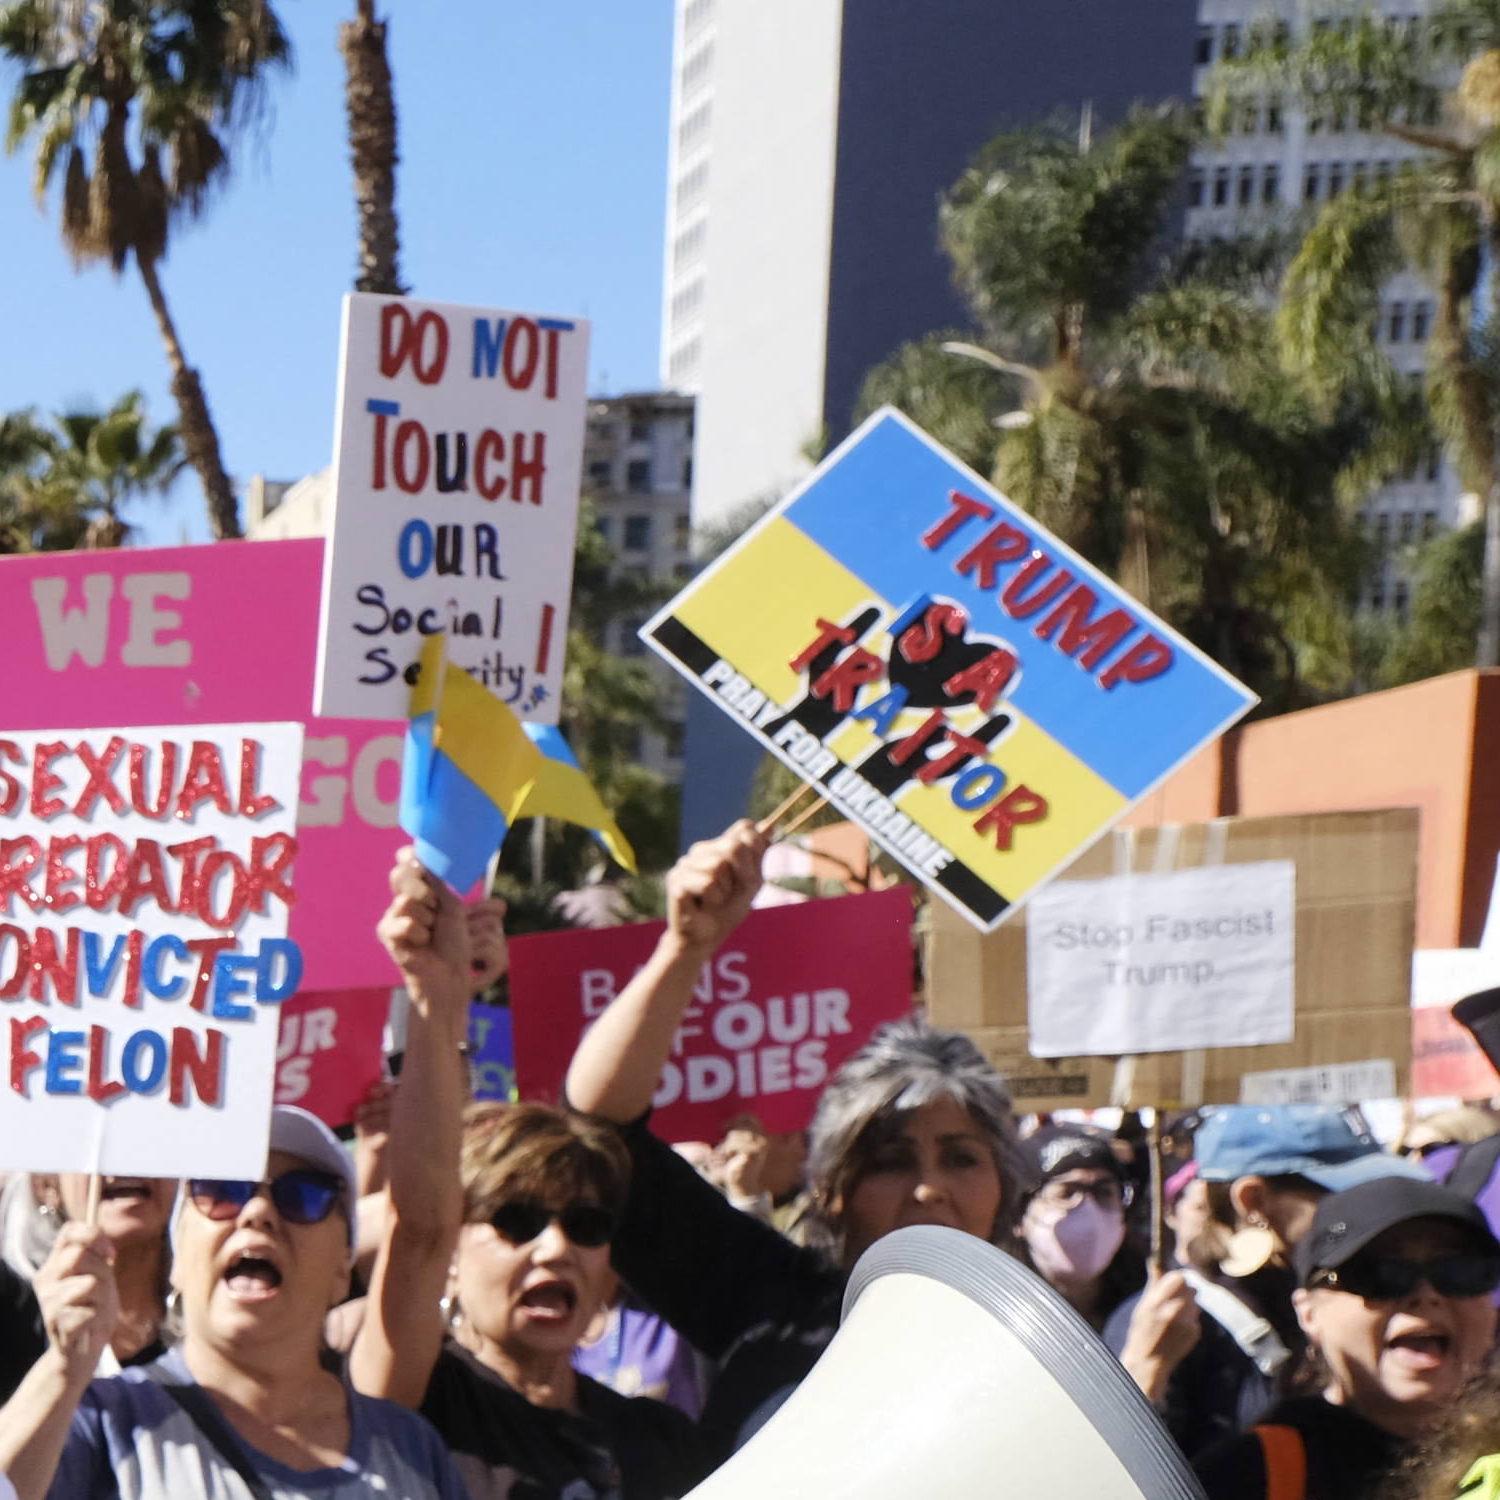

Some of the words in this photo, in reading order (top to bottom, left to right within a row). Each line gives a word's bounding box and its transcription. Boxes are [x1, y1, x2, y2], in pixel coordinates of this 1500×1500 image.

[380, 303, 449, 386] DO
[472, 317, 575, 400] NOT
[367, 398, 546, 506] TOUCH
[399, 518, 507, 580] OUR
[921, 489, 1174, 691] TRUMP
[31, 572, 192, 671] WE
[353, 585, 502, 638] Social
[888, 592, 966, 663] IS
[942, 648, 1020, 713] A
[701, 660, 776, 731] PRAY
[771, 718, 839, 778] FOR
[827, 766, 956, 878] UKRAINE
[788, 617, 1049, 852] TRAITOR
[297, 735, 404, 828] GO
[1054, 918, 1134, 953] Stop
[1146, 908, 1276, 945] Fascist
[581, 951, 750, 1017] BS
[713, 988, 852, 1051] OUR
[9, 1016, 226, 1107] FELON
[275, 1006, 338, 1063] UR
[652, 1040, 828, 1109] ODIES
